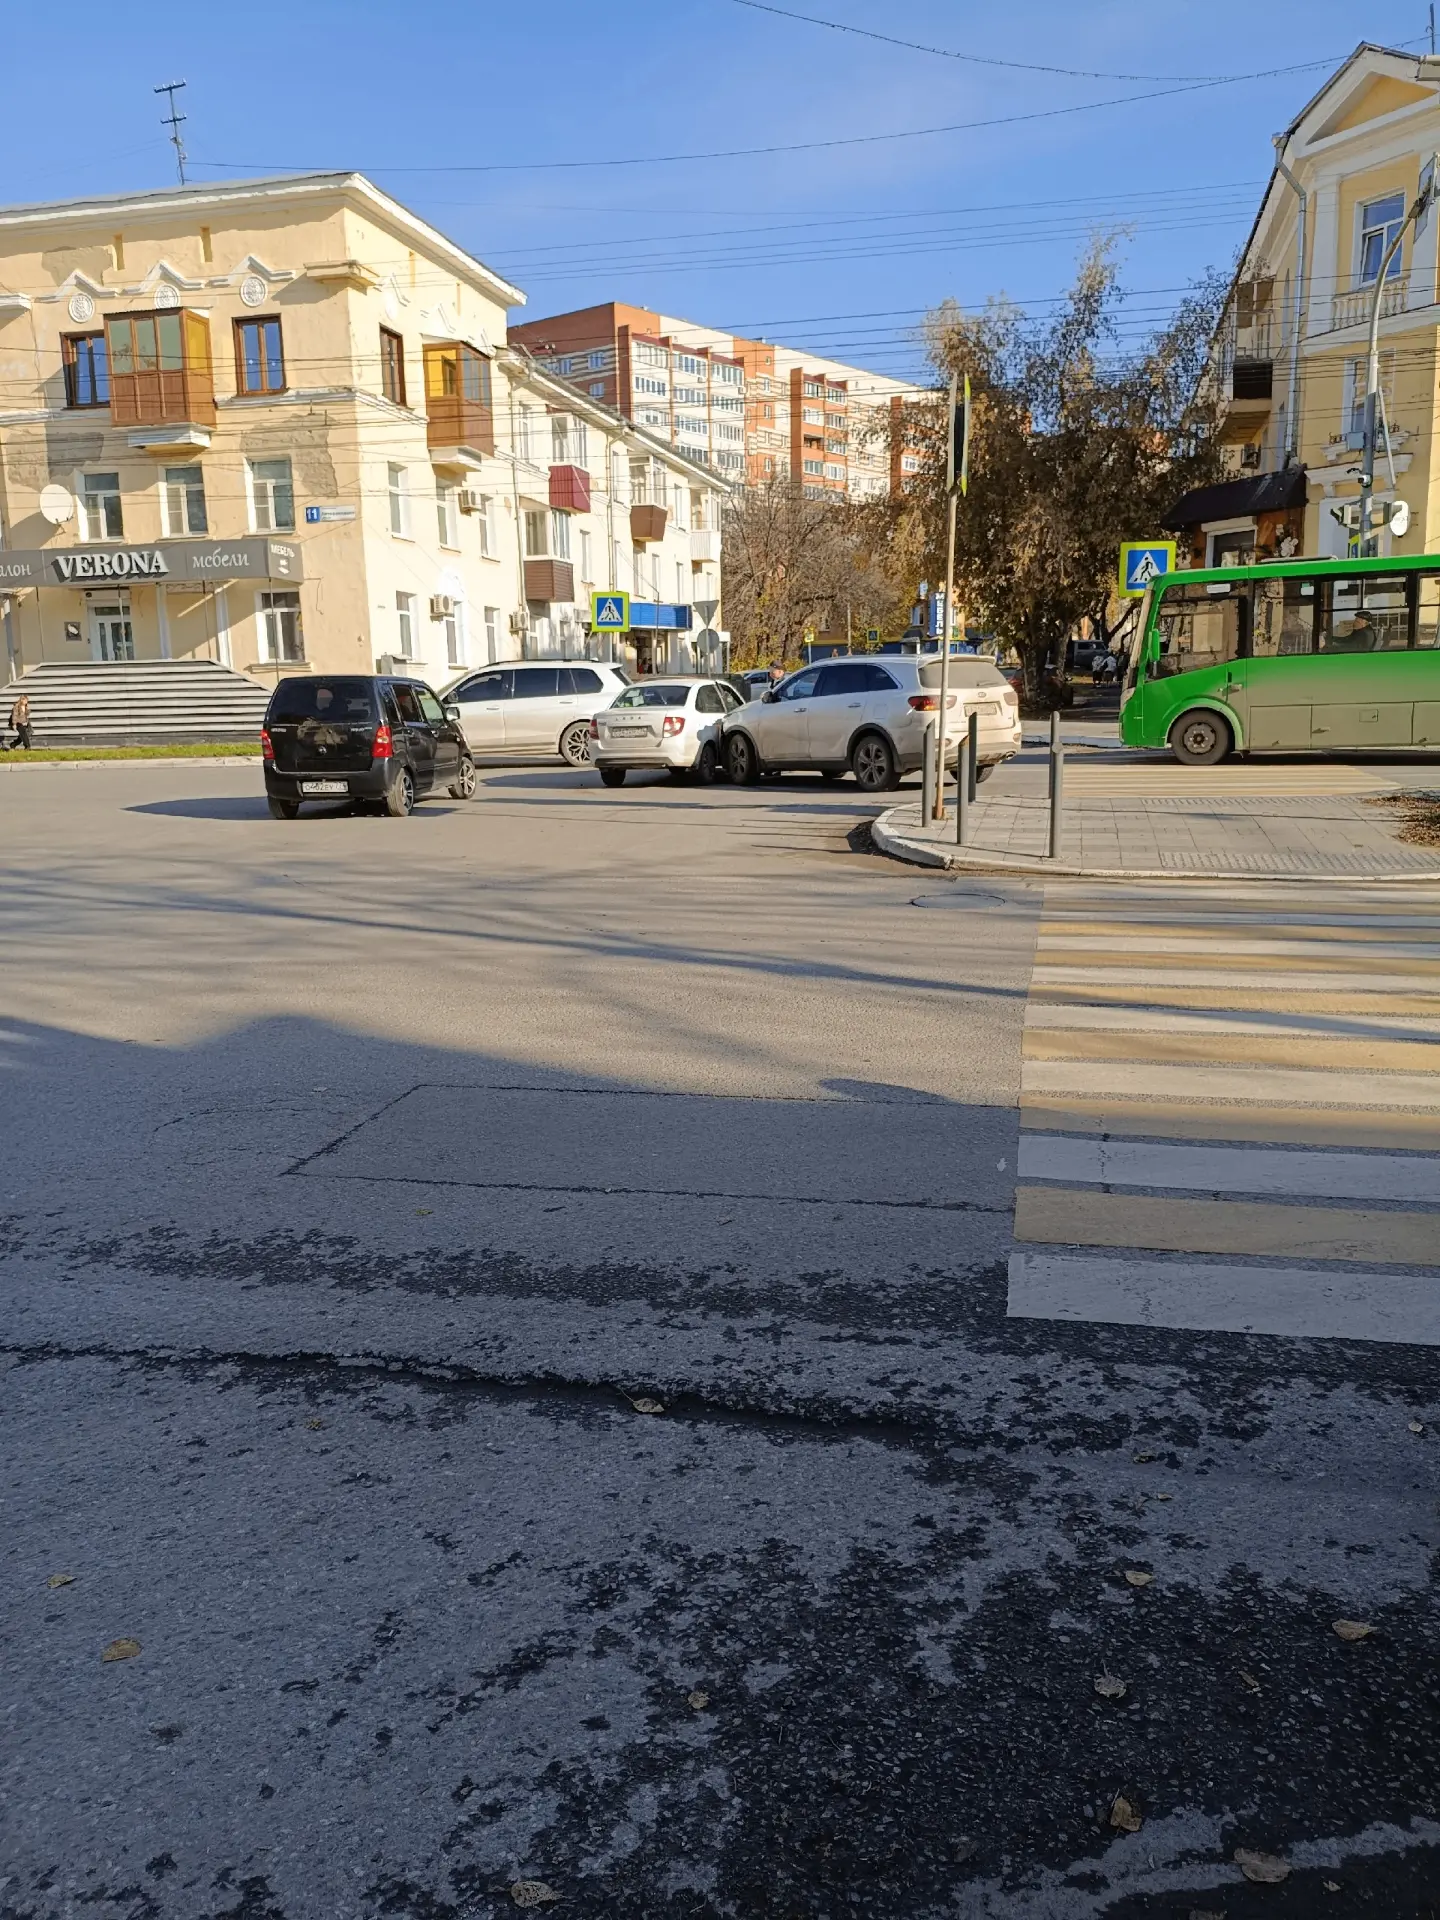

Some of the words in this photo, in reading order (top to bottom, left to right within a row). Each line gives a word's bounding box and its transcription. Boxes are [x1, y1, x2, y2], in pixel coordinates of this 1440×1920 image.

[307, 508, 318, 520] 11
[271, 544, 295, 558] МЕБЕЛЬ
[55, 550, 170, 579] VERONA
[935, 592, 945, 635] МЕБЕЛЬ
